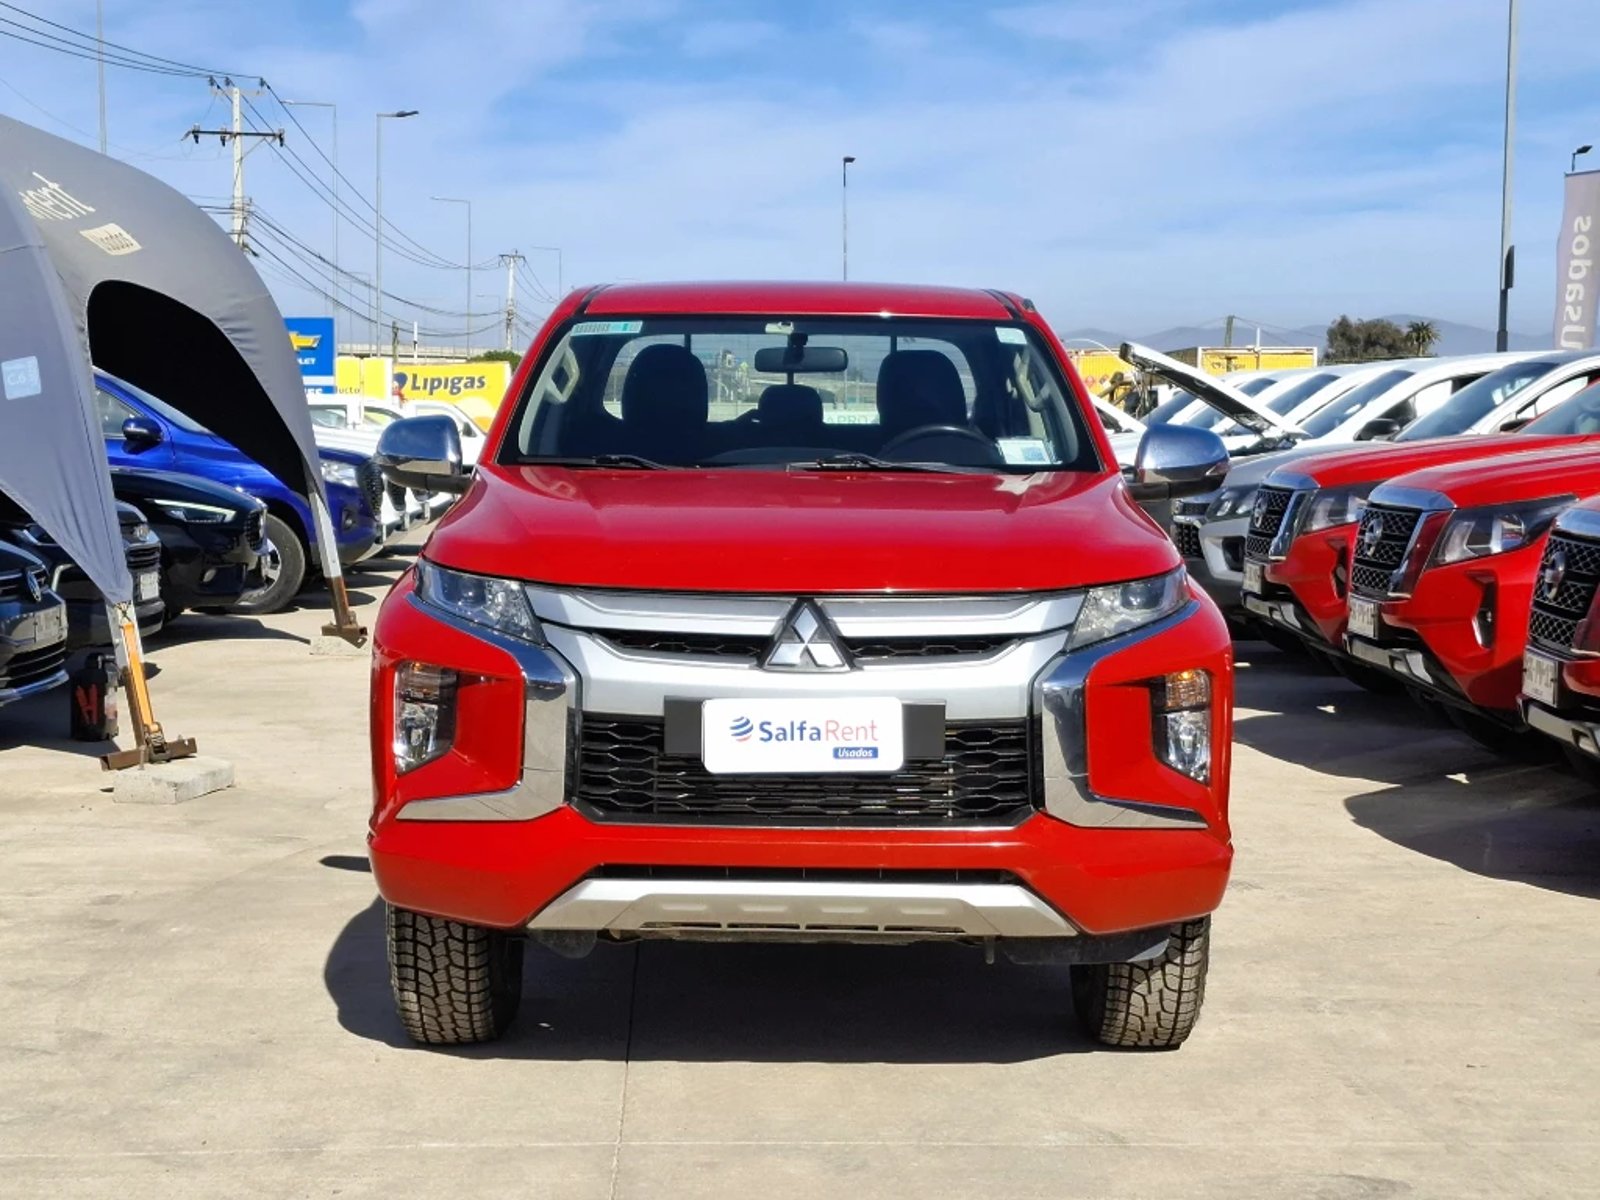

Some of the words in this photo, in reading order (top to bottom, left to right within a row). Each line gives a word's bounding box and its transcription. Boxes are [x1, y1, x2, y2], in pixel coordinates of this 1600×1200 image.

[411, 373, 485, 396] Lipigas
[759, 720, 878, 743] SalfaRent
[838, 748, 873, 757] Usados
